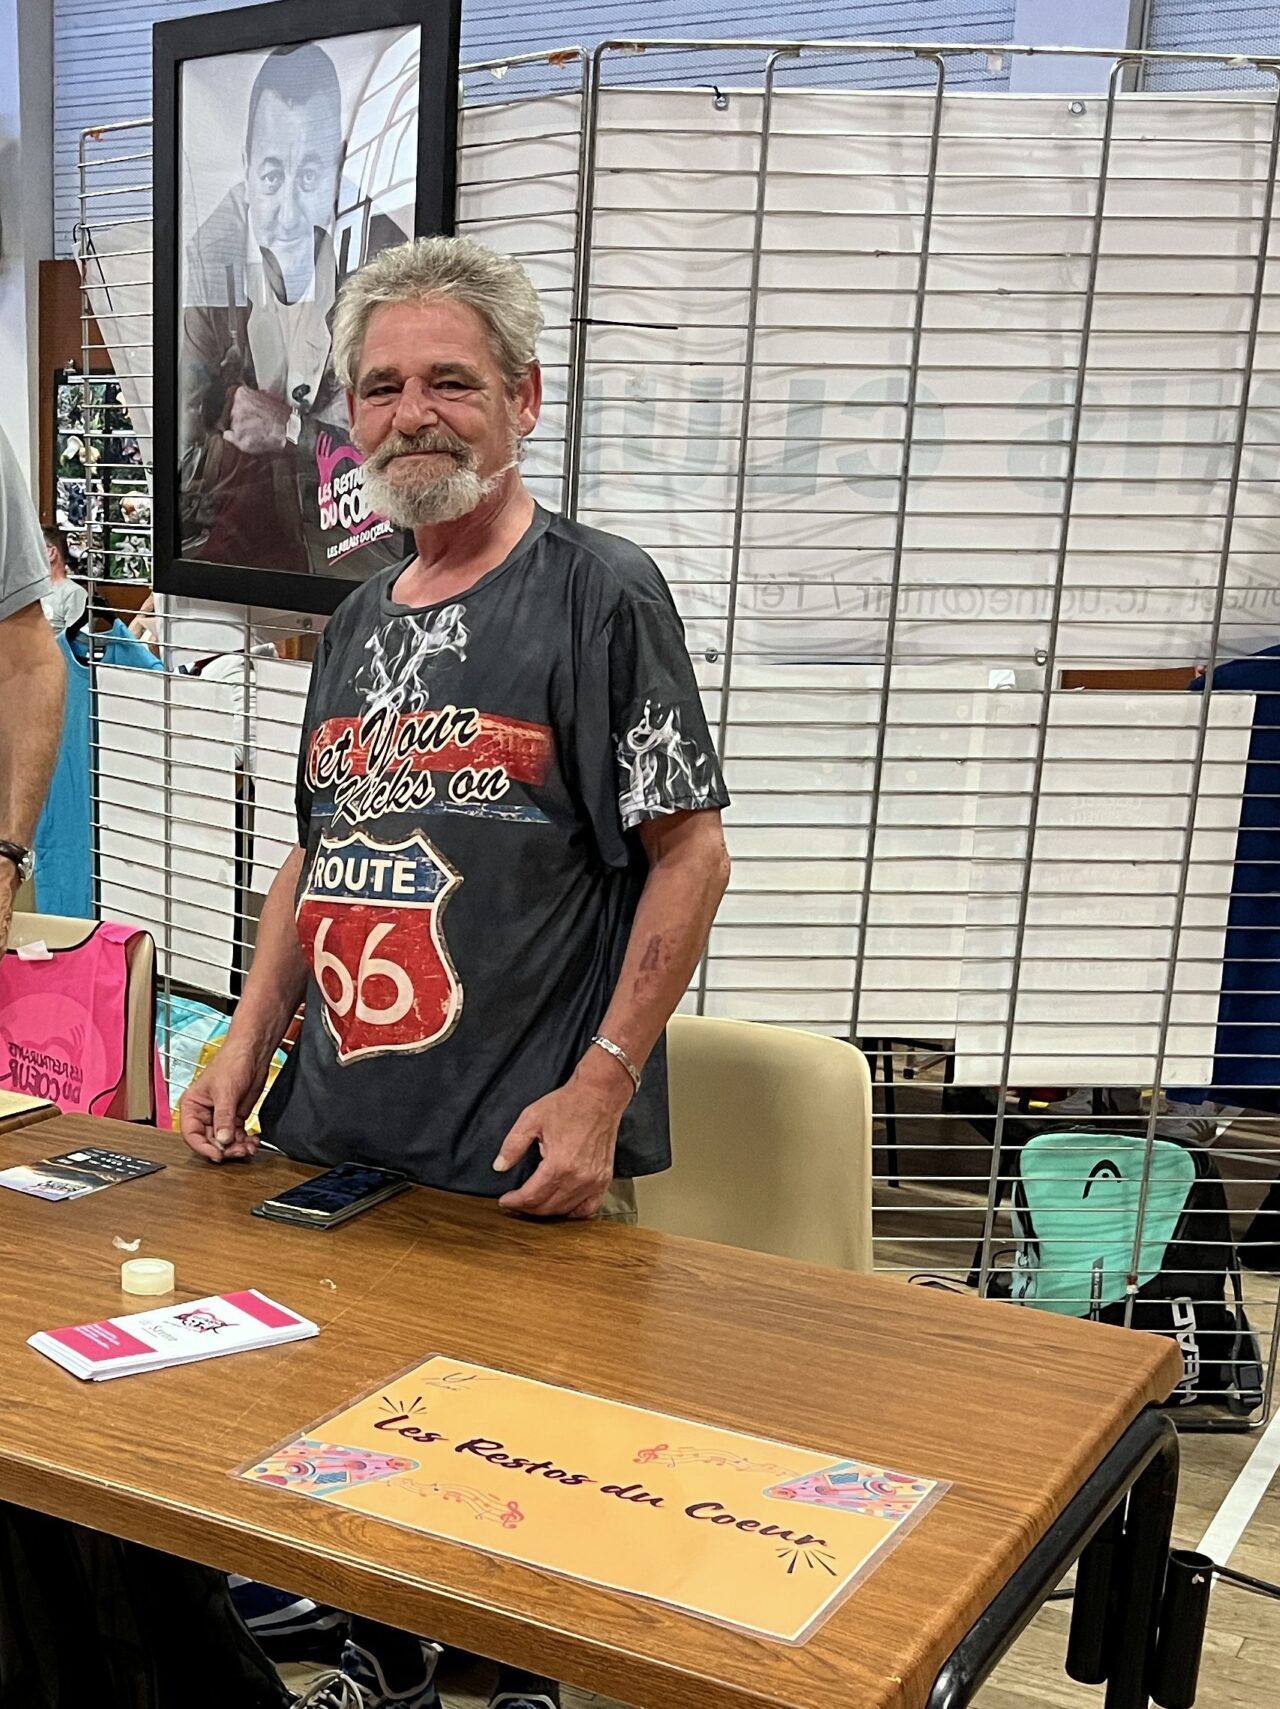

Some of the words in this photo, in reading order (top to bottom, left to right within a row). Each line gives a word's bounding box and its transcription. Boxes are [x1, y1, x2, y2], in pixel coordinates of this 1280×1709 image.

[318, 483, 332, 506] LES
[320, 501, 338, 531] DU
[327, 545, 338, 558] LES
[359, 705, 482, 779] Your
[331, 756, 436, 828] Kicks
[448, 765, 511, 804] on
[313, 856, 418, 895] ROUTE
[313, 917, 414, 1026] 66
[1172, 1296, 1200, 1406] HEAD
[374, 1413, 449, 1443] Les
[454, 1437, 599, 1487] Restos
[599, 1482, 665, 1509] du
[683, 1501, 828, 1547] Coeur
